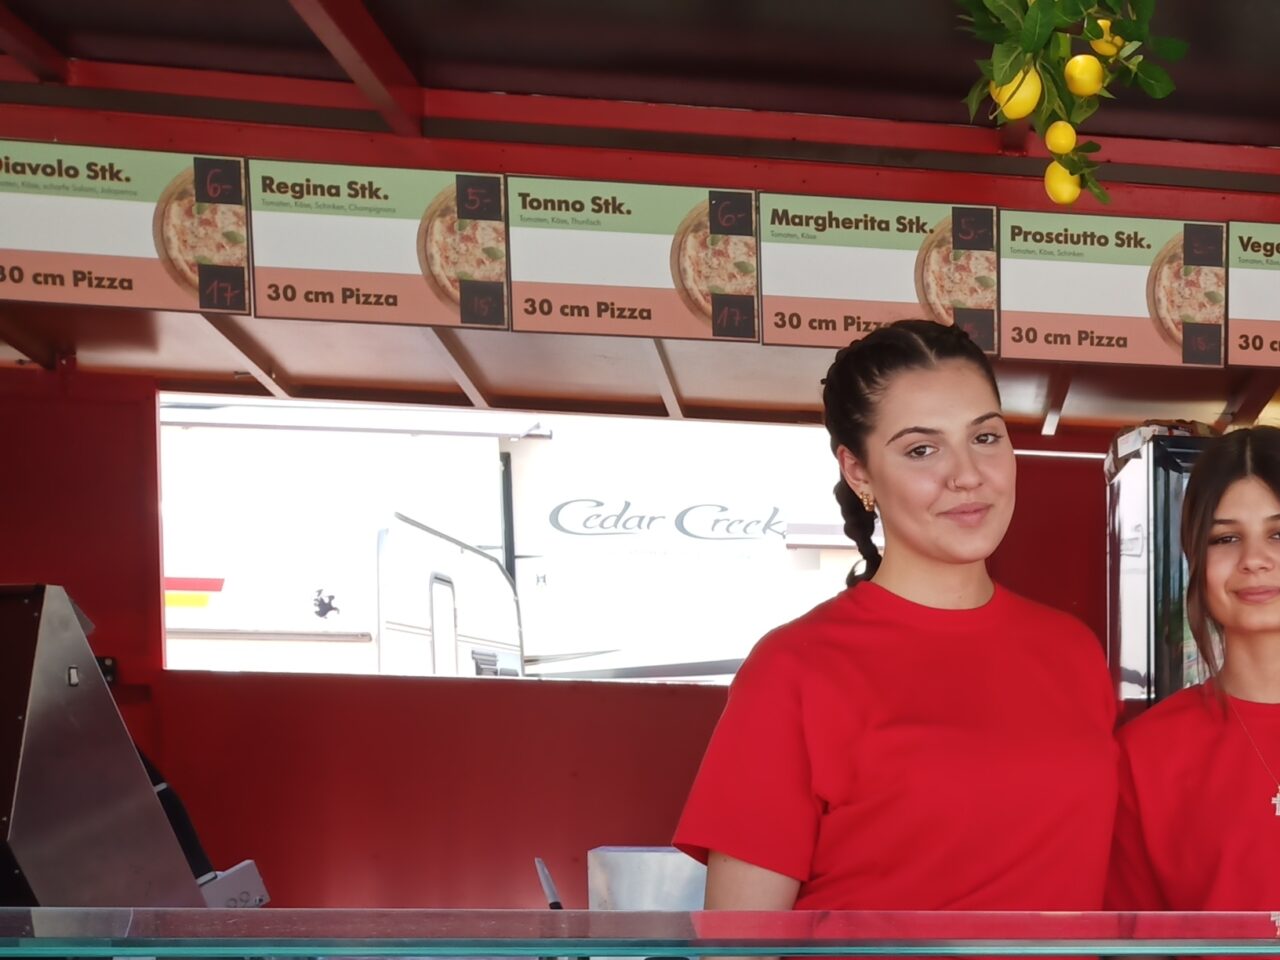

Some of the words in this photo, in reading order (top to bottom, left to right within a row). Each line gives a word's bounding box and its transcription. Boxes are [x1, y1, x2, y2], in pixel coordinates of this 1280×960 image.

[0, 156, 80, 178] iavolo
[86, 161, 131, 182] Stk.
[261, 175, 341, 199] Regina
[347, 181, 389, 200] Stk.
[518, 192, 585, 212] Tonno
[591, 195, 632, 215] Stk.
[770, 208, 890, 232] Margherita
[896, 215, 934, 234] Stk.
[1010, 225, 1109, 247] Prosciutto
[1114, 230, 1152, 250] Stk.
[32, 272, 65, 286] cm
[72, 270, 133, 290] Pizza
[267, 284, 297, 302] 30
[304, 289, 335, 305] cm
[341, 287, 398, 307] Pizza
[523, 298, 553, 316] 30
[559, 303, 590, 318] cm
[597, 301, 652, 320] Pizza
[774, 311, 801, 329] 30
[808, 317, 837, 330] cm
[843, 315, 890, 332] Pizz
[1011, 326, 1037, 344] 30
[1044, 332, 1071, 345] cm
[1077, 330, 1128, 348] Pizza
[1238, 334, 1263, 351] 30
[549, 499, 666, 536] Cedar
[674, 504, 787, 540] Creek
